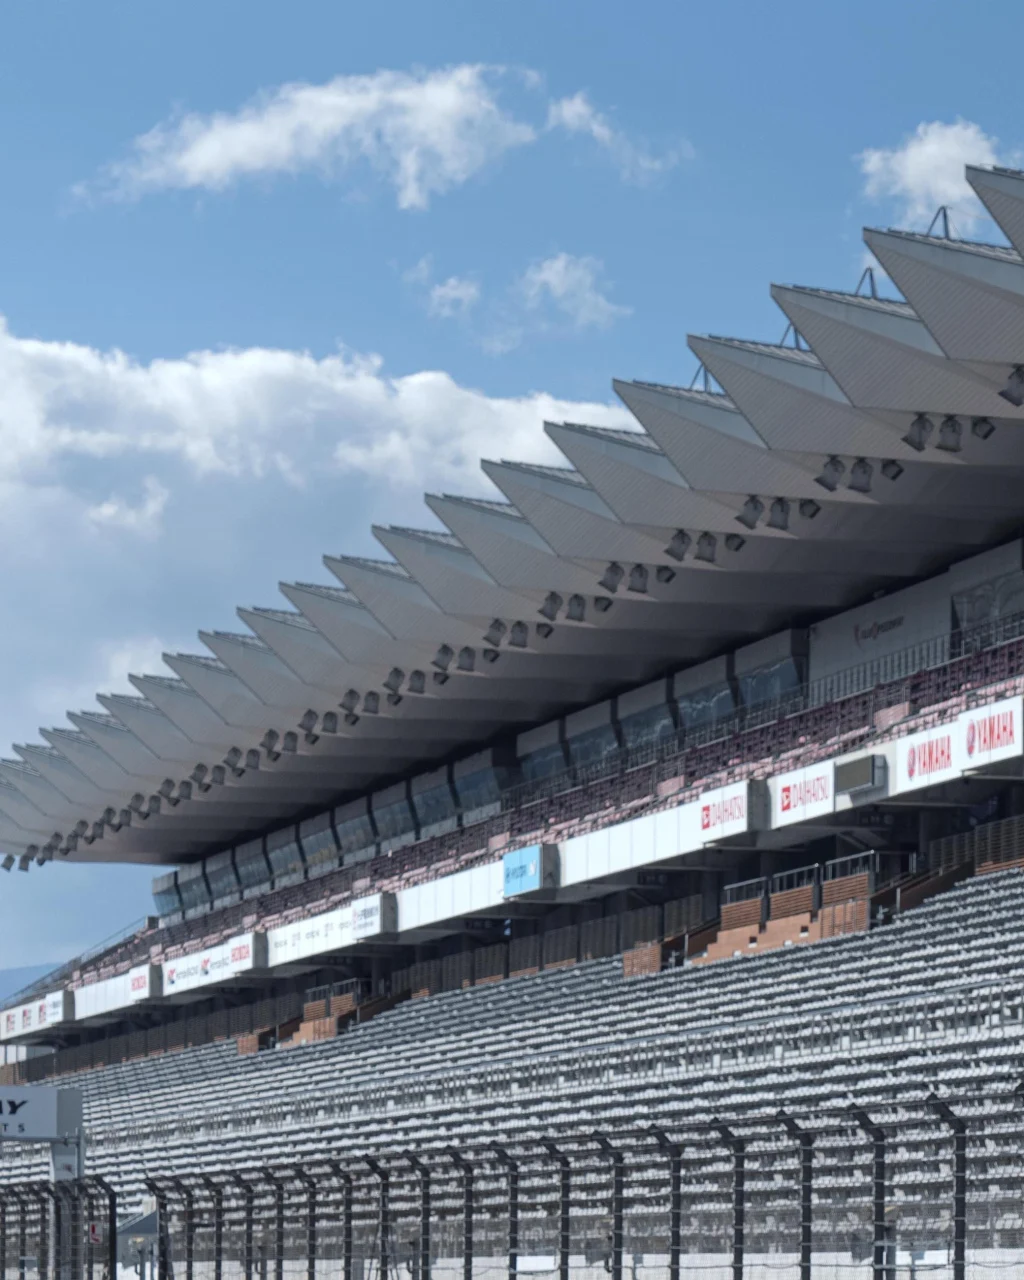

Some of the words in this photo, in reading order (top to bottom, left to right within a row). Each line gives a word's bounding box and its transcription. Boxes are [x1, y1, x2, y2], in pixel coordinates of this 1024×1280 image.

[976, 710, 1015, 754] YAMAHA
[917, 734, 952, 777] YAMAHA
[792, 775, 829, 809] DAIHATSU
[710, 794, 745, 827] DAIHATSU
[0, 1099, 28, 1115] Y
